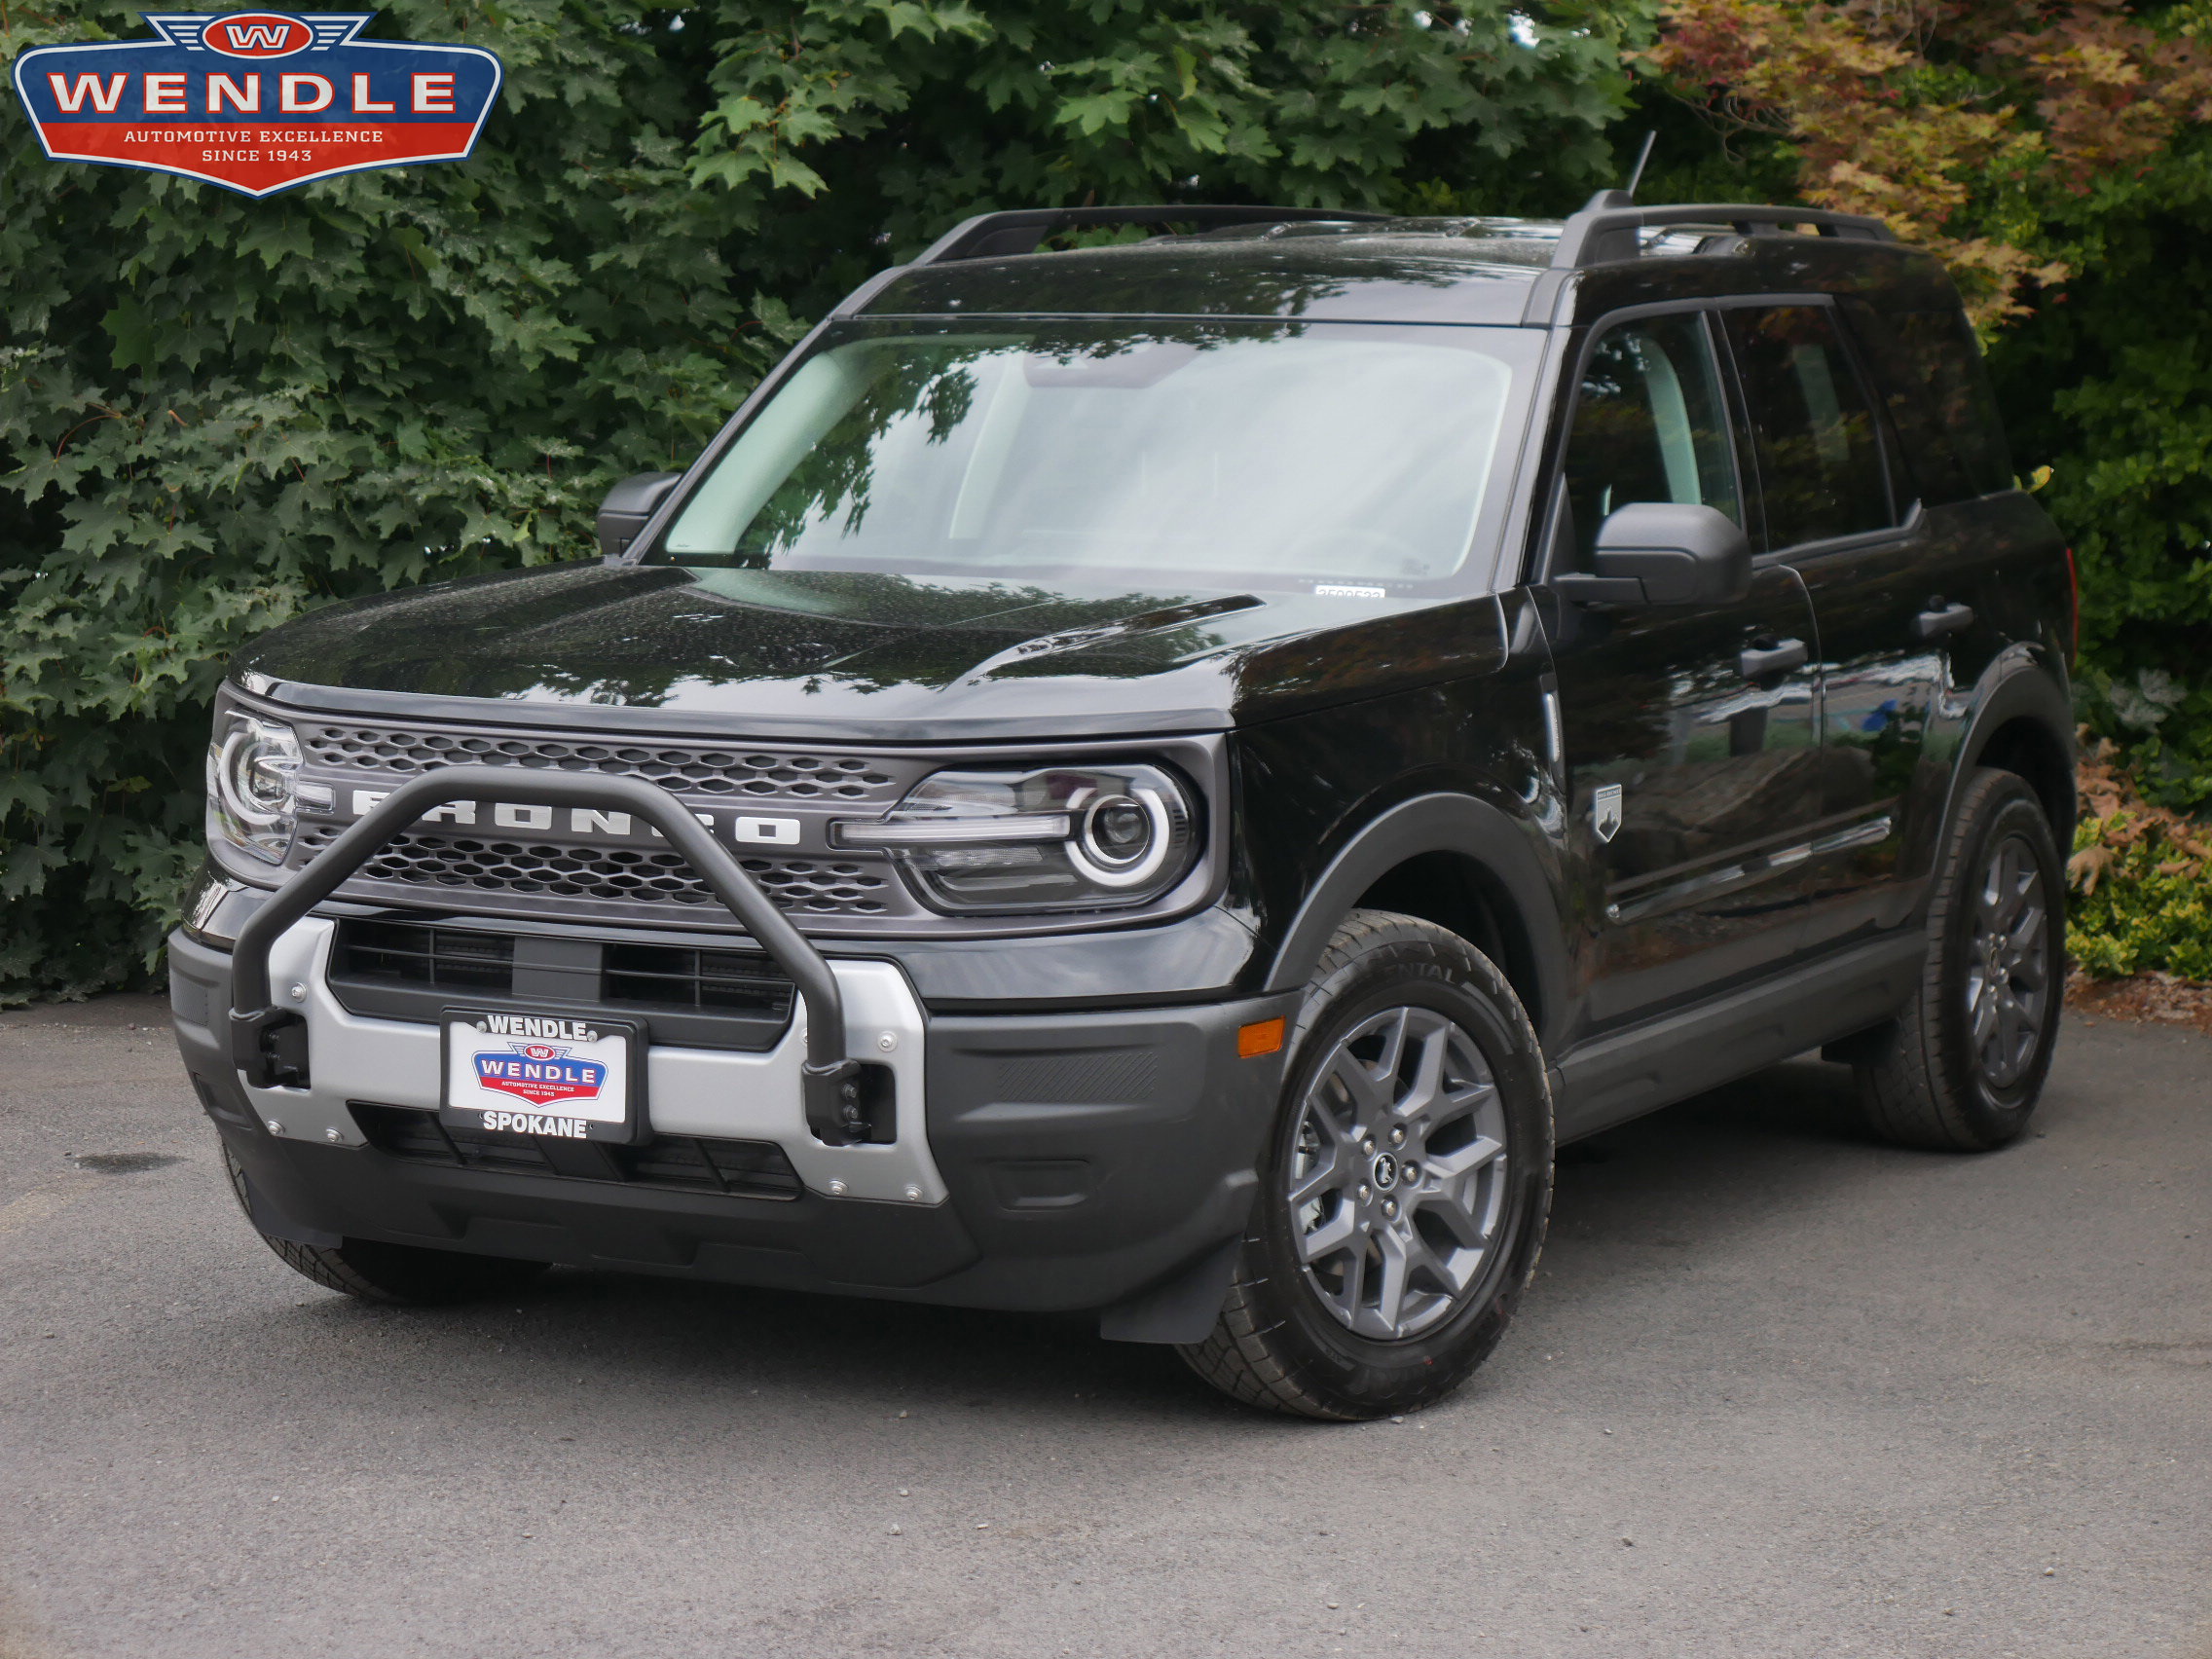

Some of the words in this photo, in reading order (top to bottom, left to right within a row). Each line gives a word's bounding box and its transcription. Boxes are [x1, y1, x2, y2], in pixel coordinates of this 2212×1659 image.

[487, 1014, 588, 1042] WENDLE
[481, 1058, 596, 1084] WENDLE
[501, 1081, 538, 1089] AUTOMOTIVE
[538, 1084, 575, 1092] EXCELLENCE
[483, 1110, 587, 1139] SPOKANE
